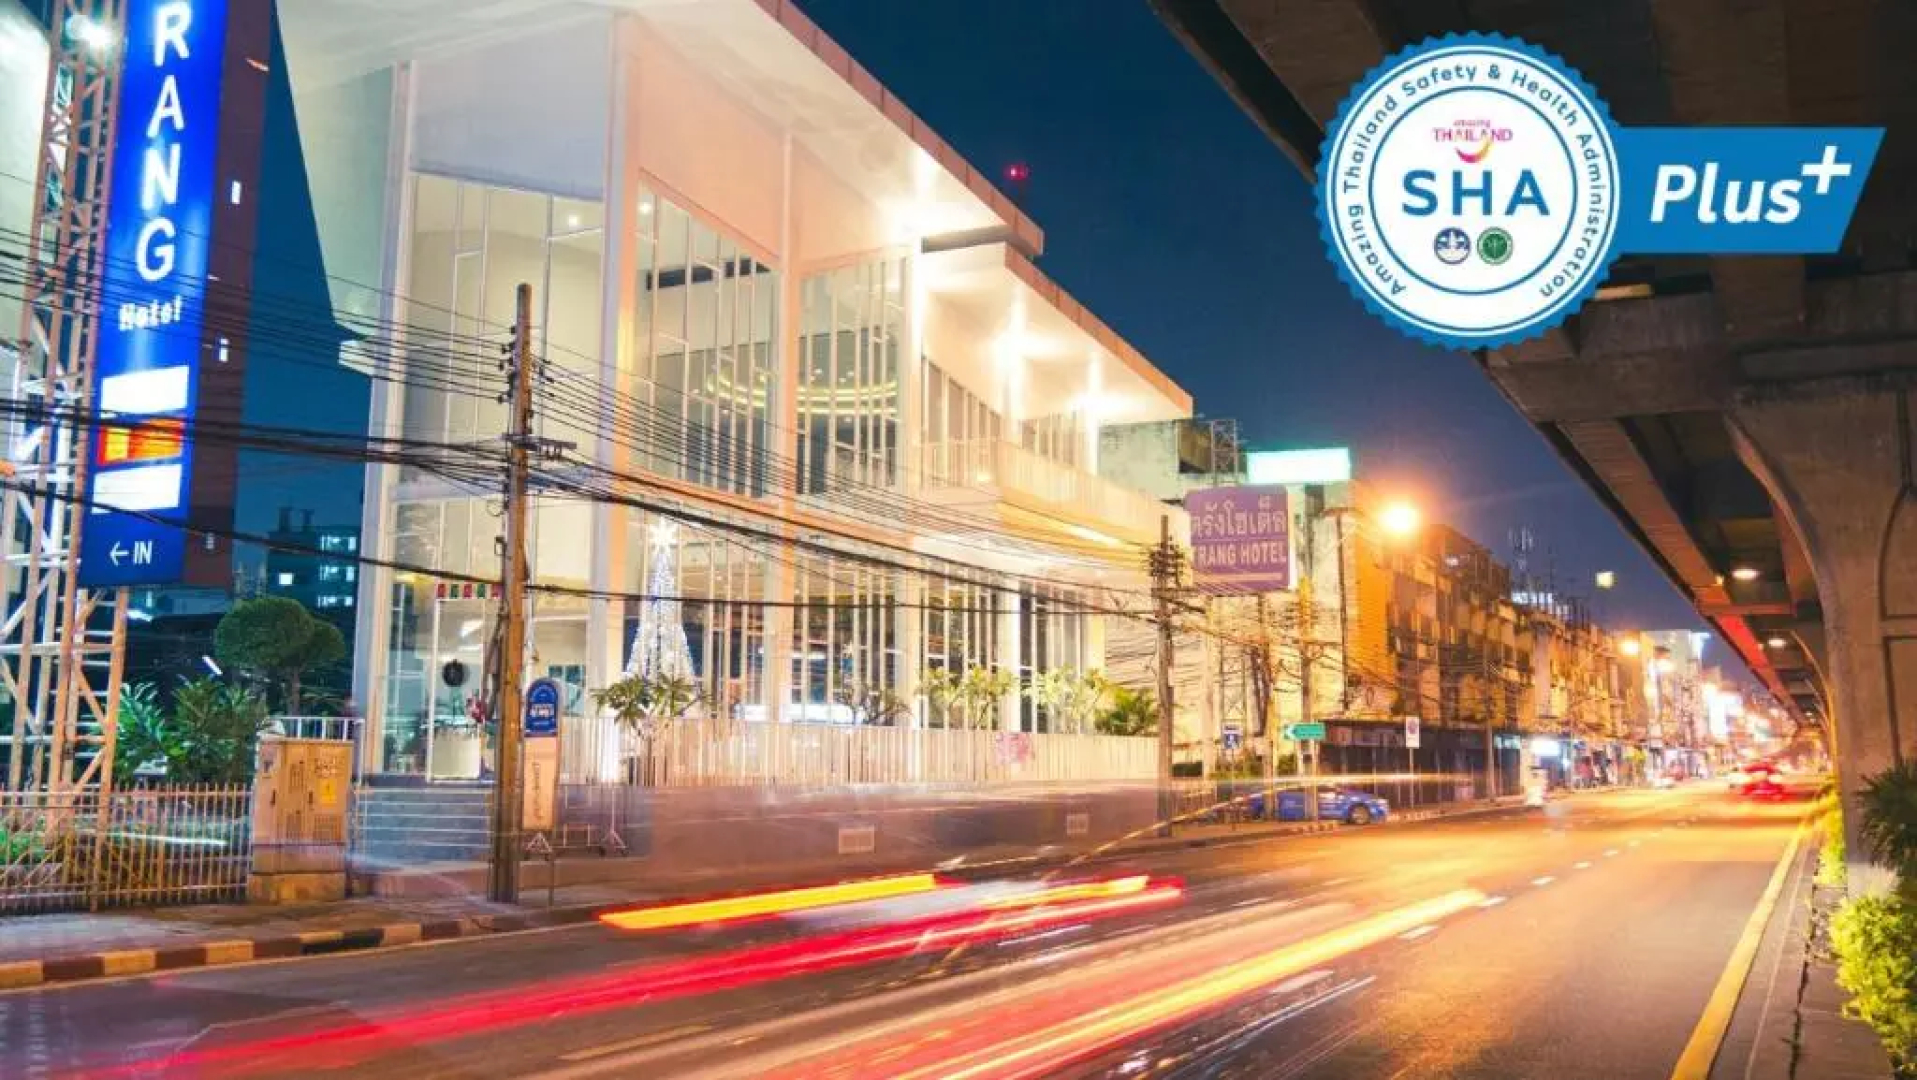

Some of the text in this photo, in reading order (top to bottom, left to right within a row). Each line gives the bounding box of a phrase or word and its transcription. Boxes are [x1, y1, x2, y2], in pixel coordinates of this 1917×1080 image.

[136, 0, 193, 282] RANG
[118, 295, 182, 331] Hotel
[133, 540, 153, 564] IN
[1241, 542, 1287, 565] HOTEL
